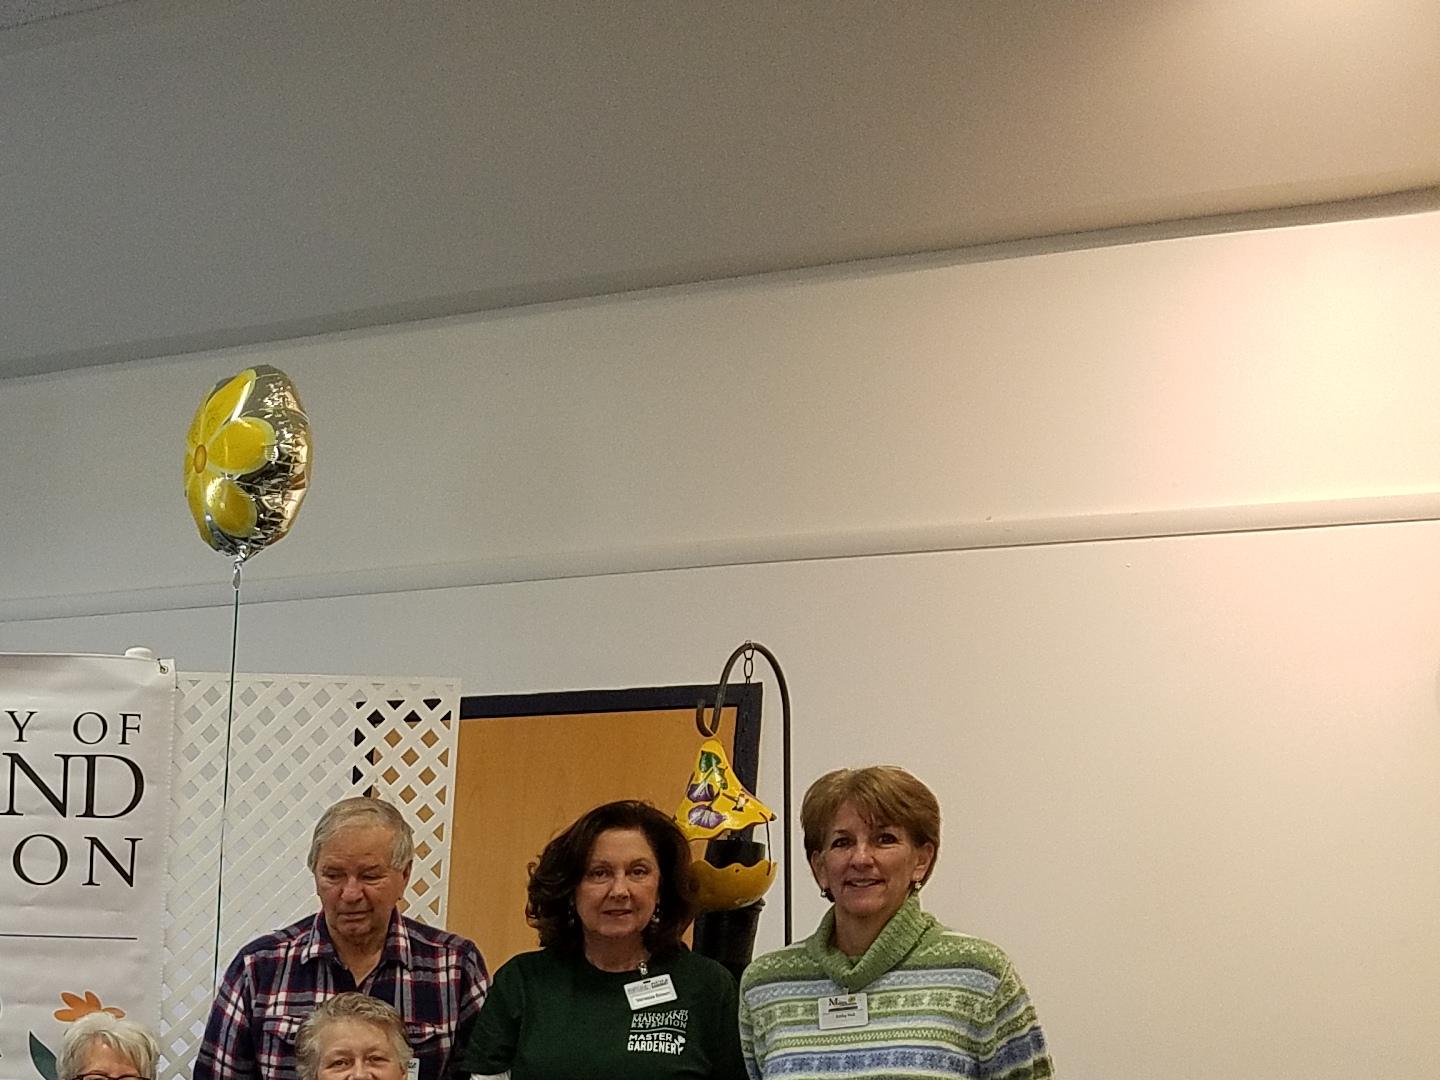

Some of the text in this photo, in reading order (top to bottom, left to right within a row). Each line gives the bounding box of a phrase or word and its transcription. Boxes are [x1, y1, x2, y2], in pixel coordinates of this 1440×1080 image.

[73, 711, 142, 745] OF
[629, 1033, 672, 1042] MASTER
[627, 1041, 677, 1055] GARDENER
